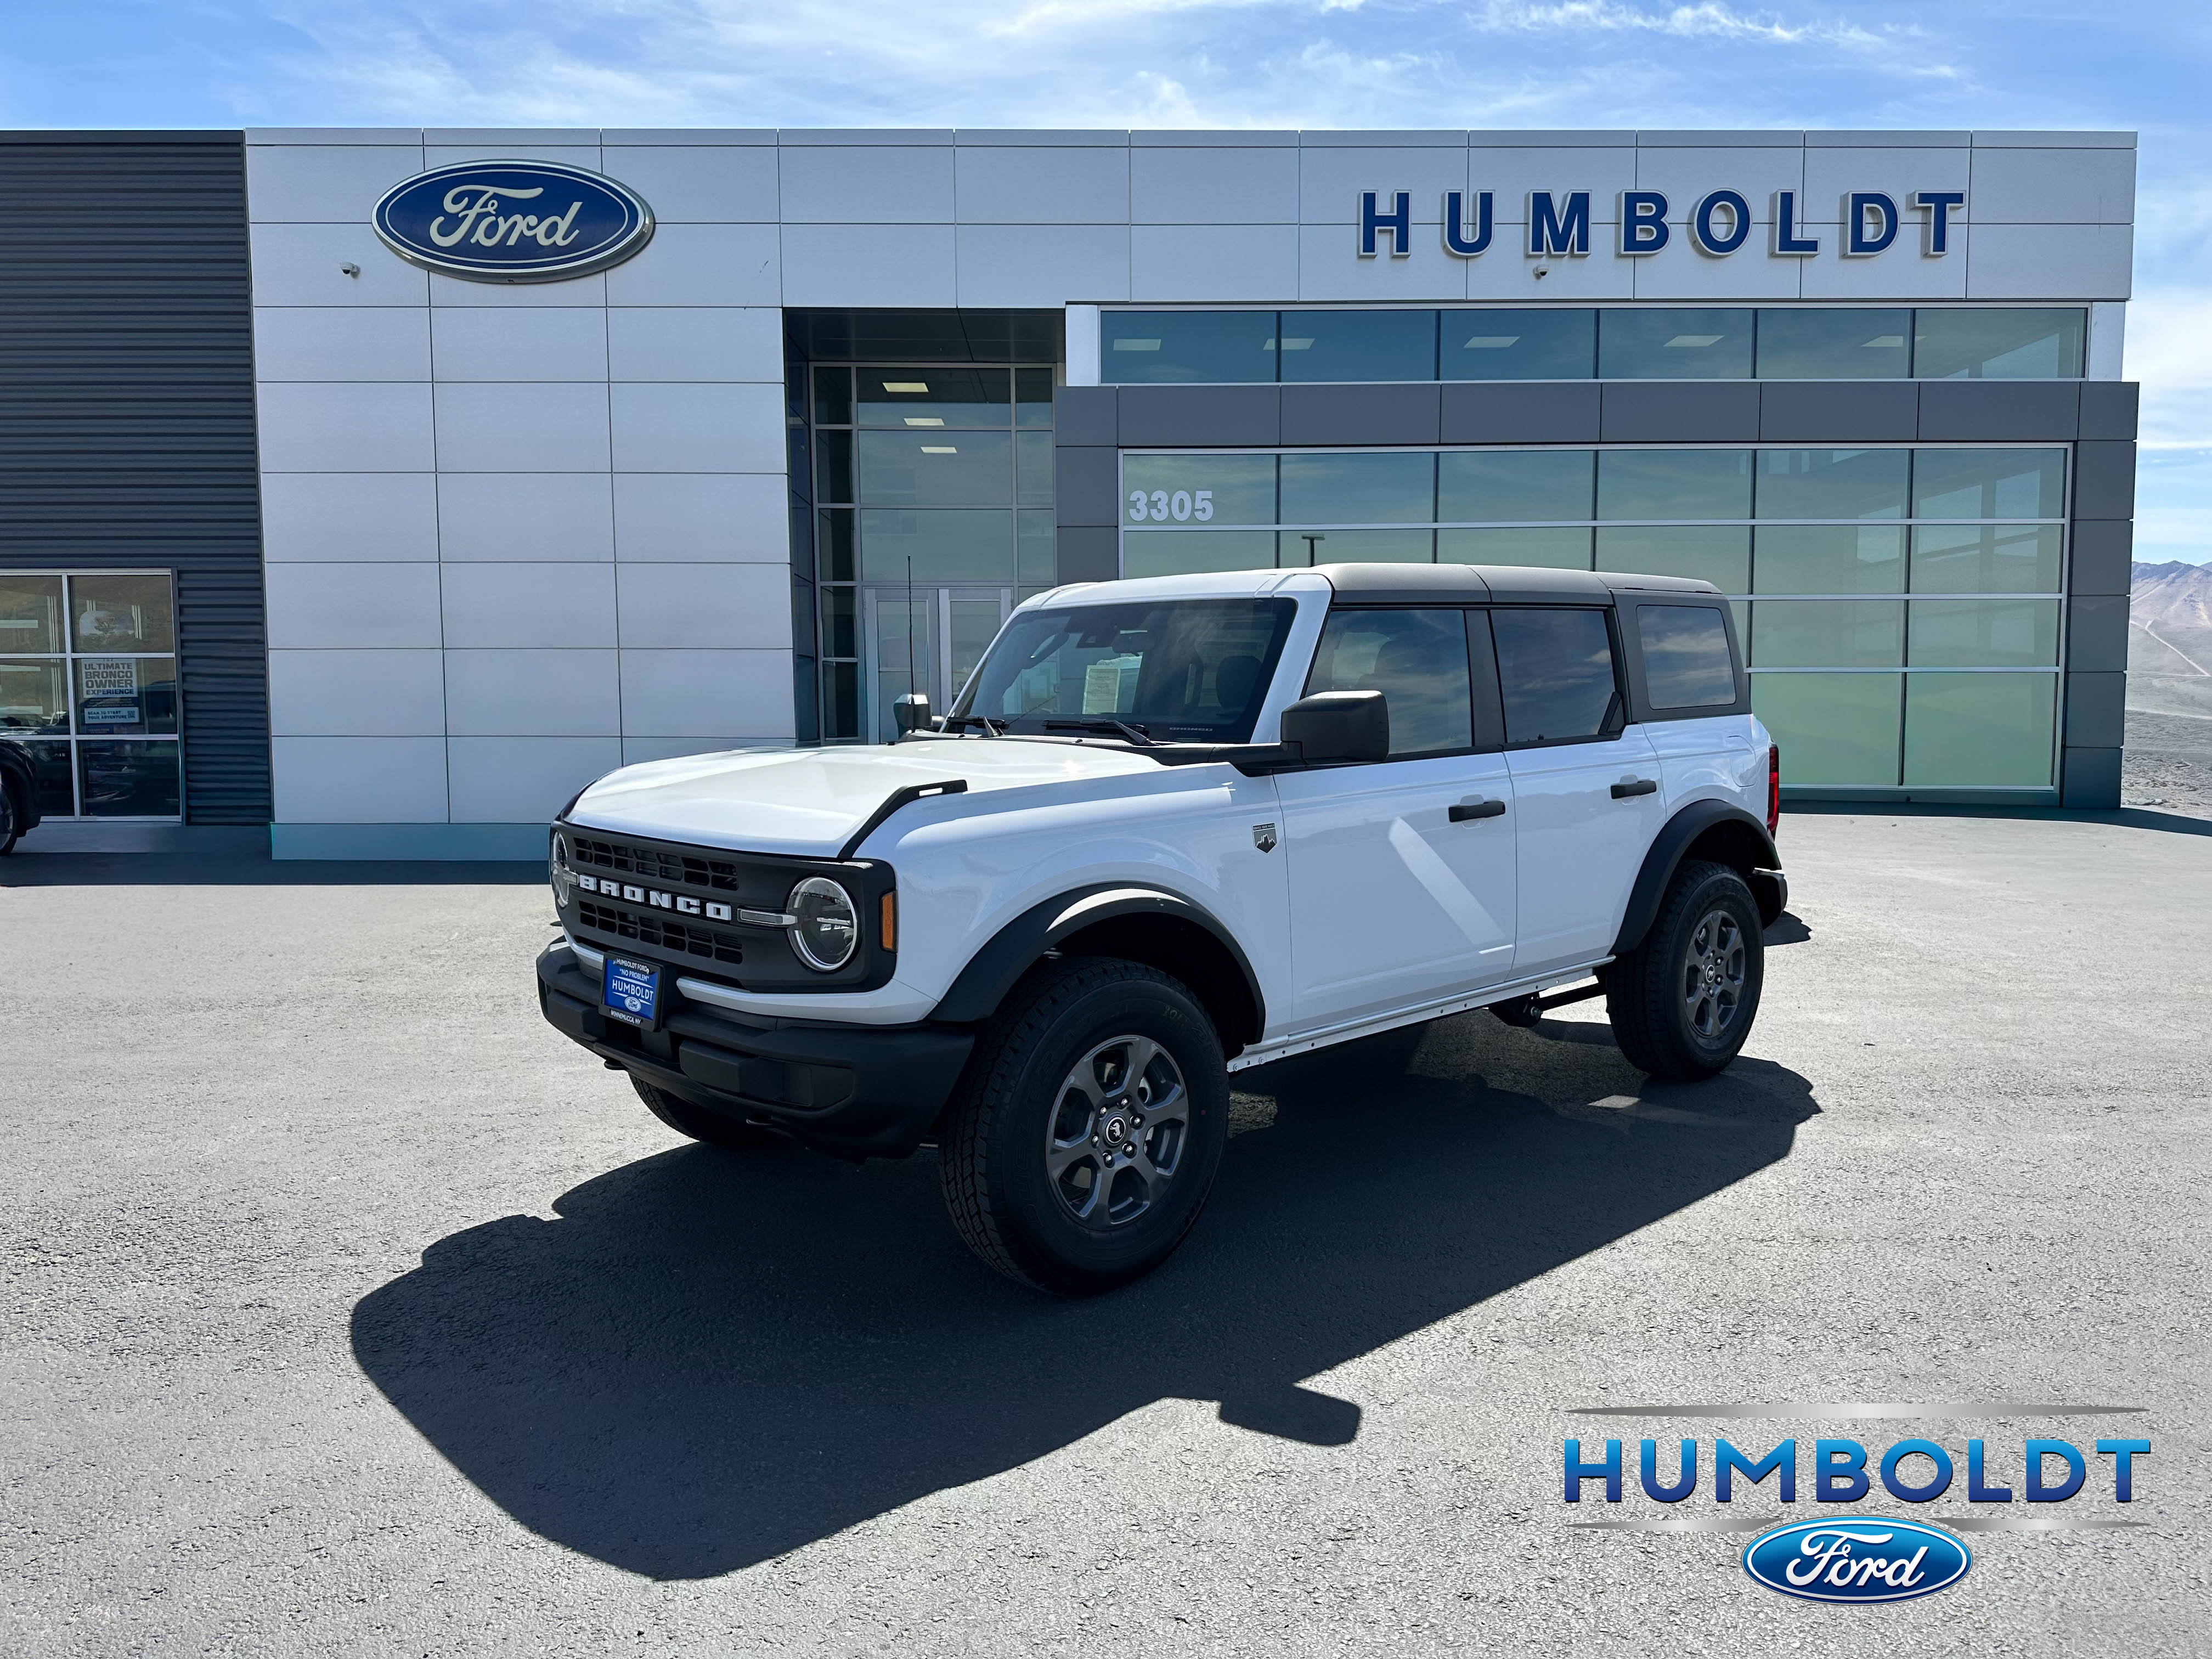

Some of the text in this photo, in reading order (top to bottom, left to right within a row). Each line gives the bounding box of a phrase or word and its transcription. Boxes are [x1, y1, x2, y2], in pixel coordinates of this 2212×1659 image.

[430, 184, 583, 247] Ford
[1357, 189, 1967, 258] HUMBOLDT
[1128, 490, 1214, 522] 3305
[84, 670, 133, 679] BRONCO
[85, 679, 133, 689] OWNER
[579, 874, 732, 921] BRONCO
[616, 958, 647, 972] HUMBOLDT FORD
[612, 979, 653, 1001] HUMBOLDT
